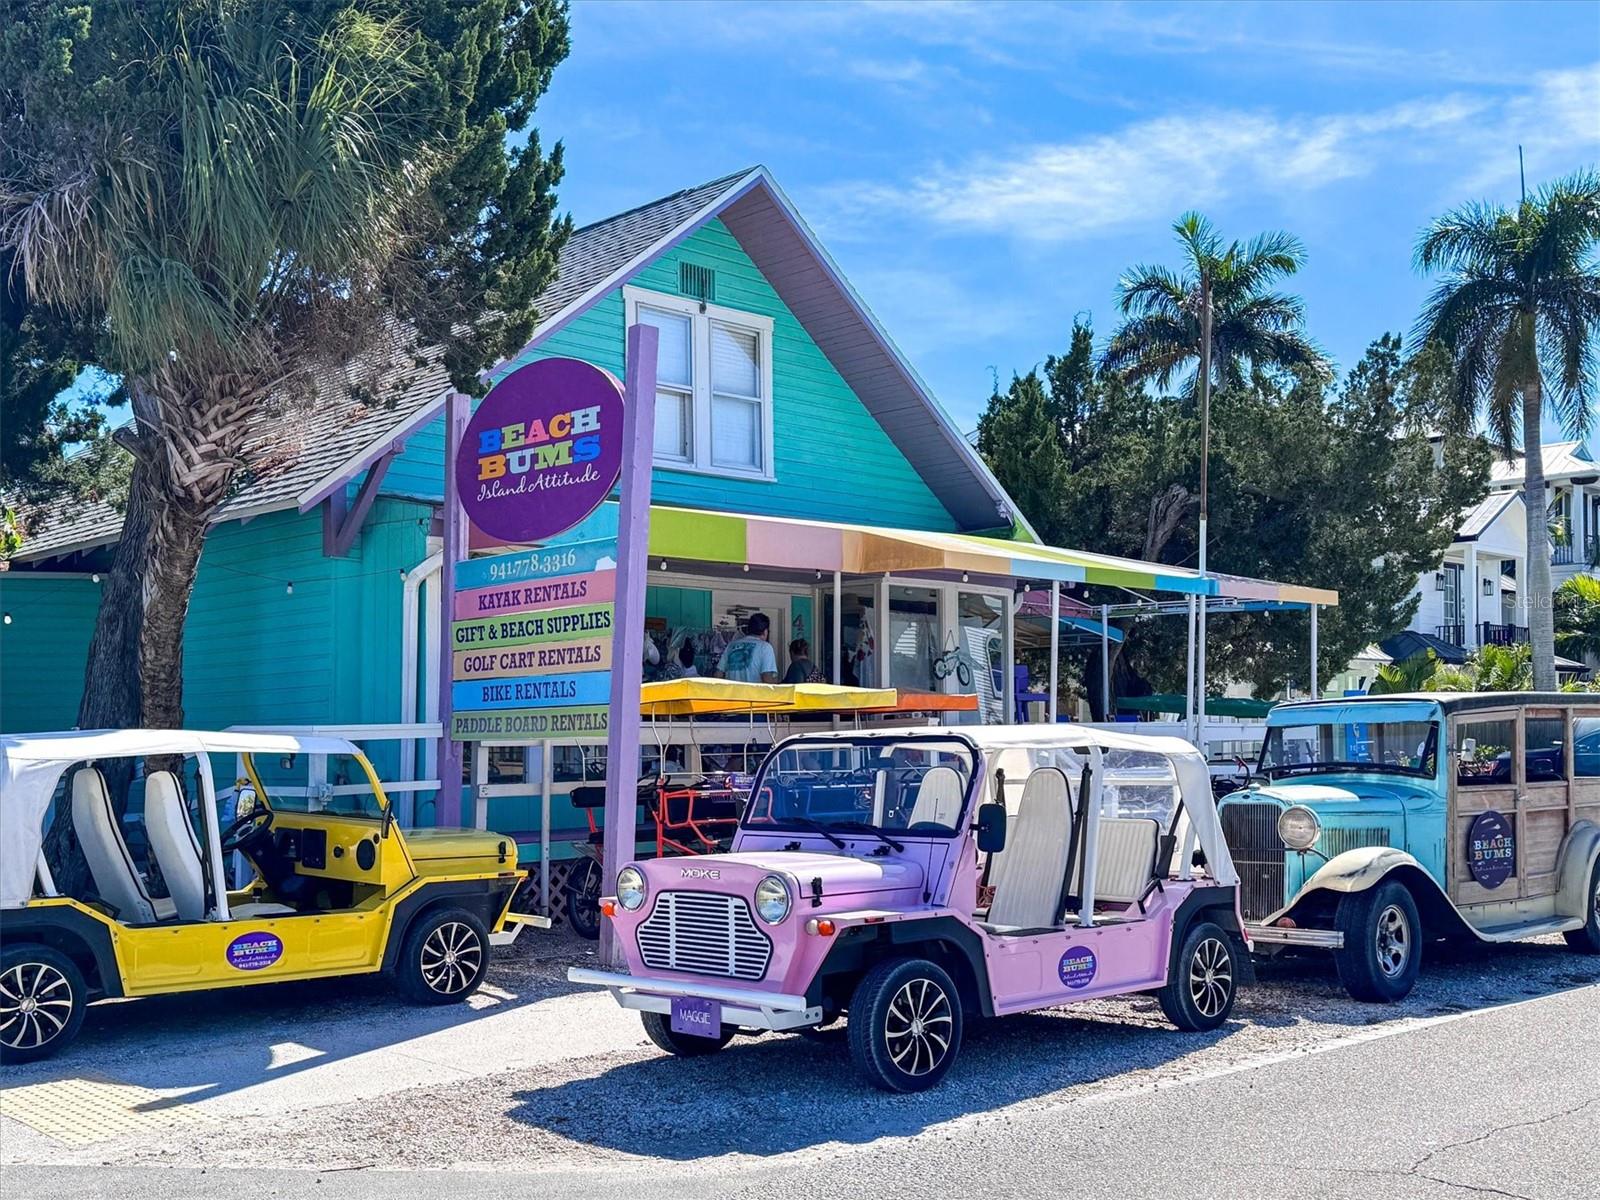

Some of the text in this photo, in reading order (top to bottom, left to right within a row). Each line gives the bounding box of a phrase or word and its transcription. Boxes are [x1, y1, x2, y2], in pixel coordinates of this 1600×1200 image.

[478, 405, 601, 454] BEACH
[477, 434, 601, 481] BUMS
[477, 463, 600, 502] Island Attitude
[490, 549, 576, 581] 941.778.3316
[478, 580, 587, 611] KAYAK RENTALS
[455, 610, 611, 643] GIFT & BEACH SUPPLIES
[463, 645, 601, 673] GOLF CART RENTALS
[482, 680, 576, 702] BIKE RENTALS
[455, 712, 608, 734] PADDLE BOARD RENTALS
[1474, 838, 1512, 850] BEACH
[1474, 848, 1512, 860] BUMS
[680, 868, 720, 880] MOKE
[233, 940, 277, 951] BEACH
[679, 1008, 711, 1025] MAGGIE
